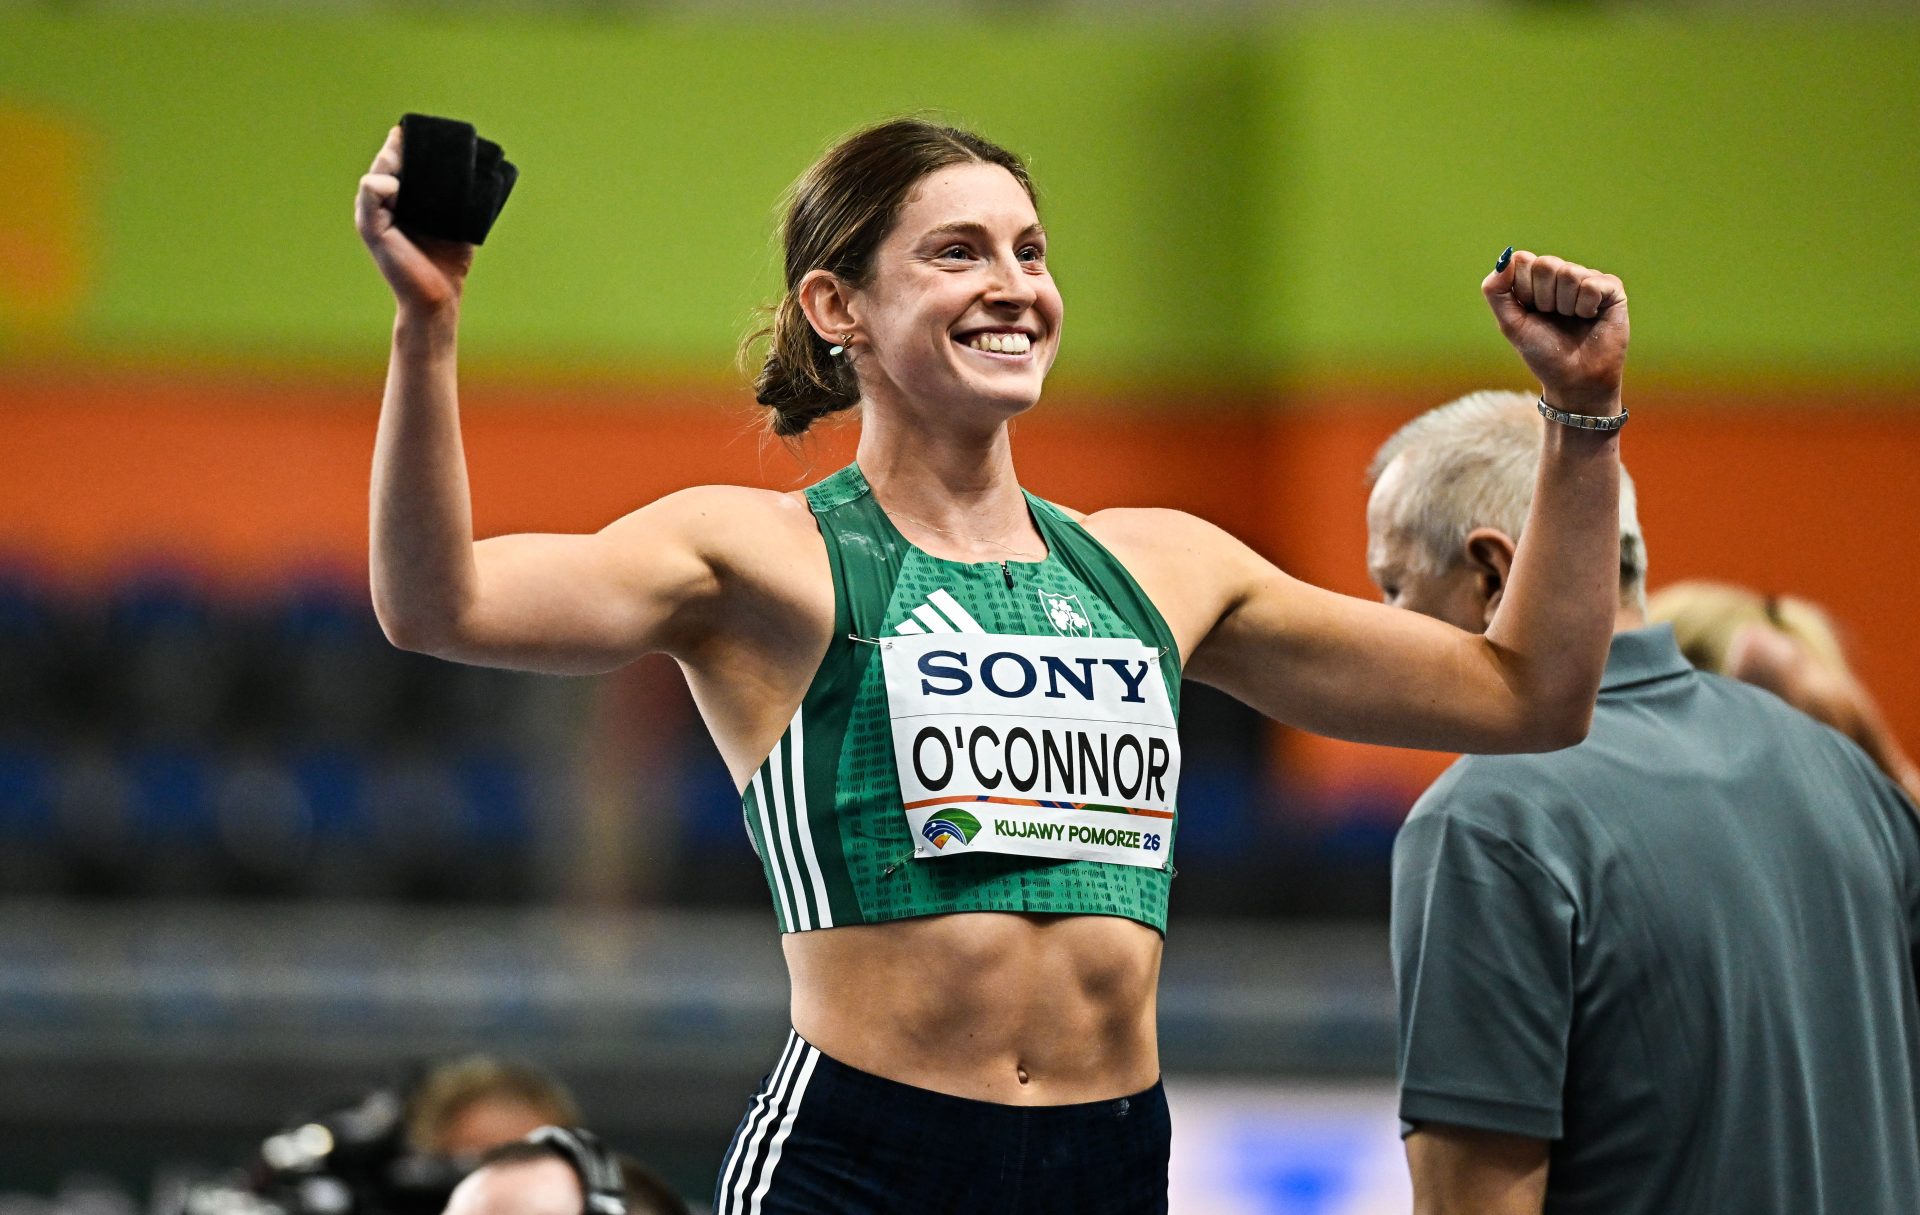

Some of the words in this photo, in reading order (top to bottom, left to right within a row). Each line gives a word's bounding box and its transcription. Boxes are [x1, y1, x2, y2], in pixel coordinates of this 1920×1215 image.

[917, 650, 1149, 703] SONY
[912, 725, 1170, 802] O'CONNOR
[994, 819, 1066, 841] KUJAWY
[1068, 825, 1141, 849] POMORZE
[1143, 833, 1161, 851] 26
